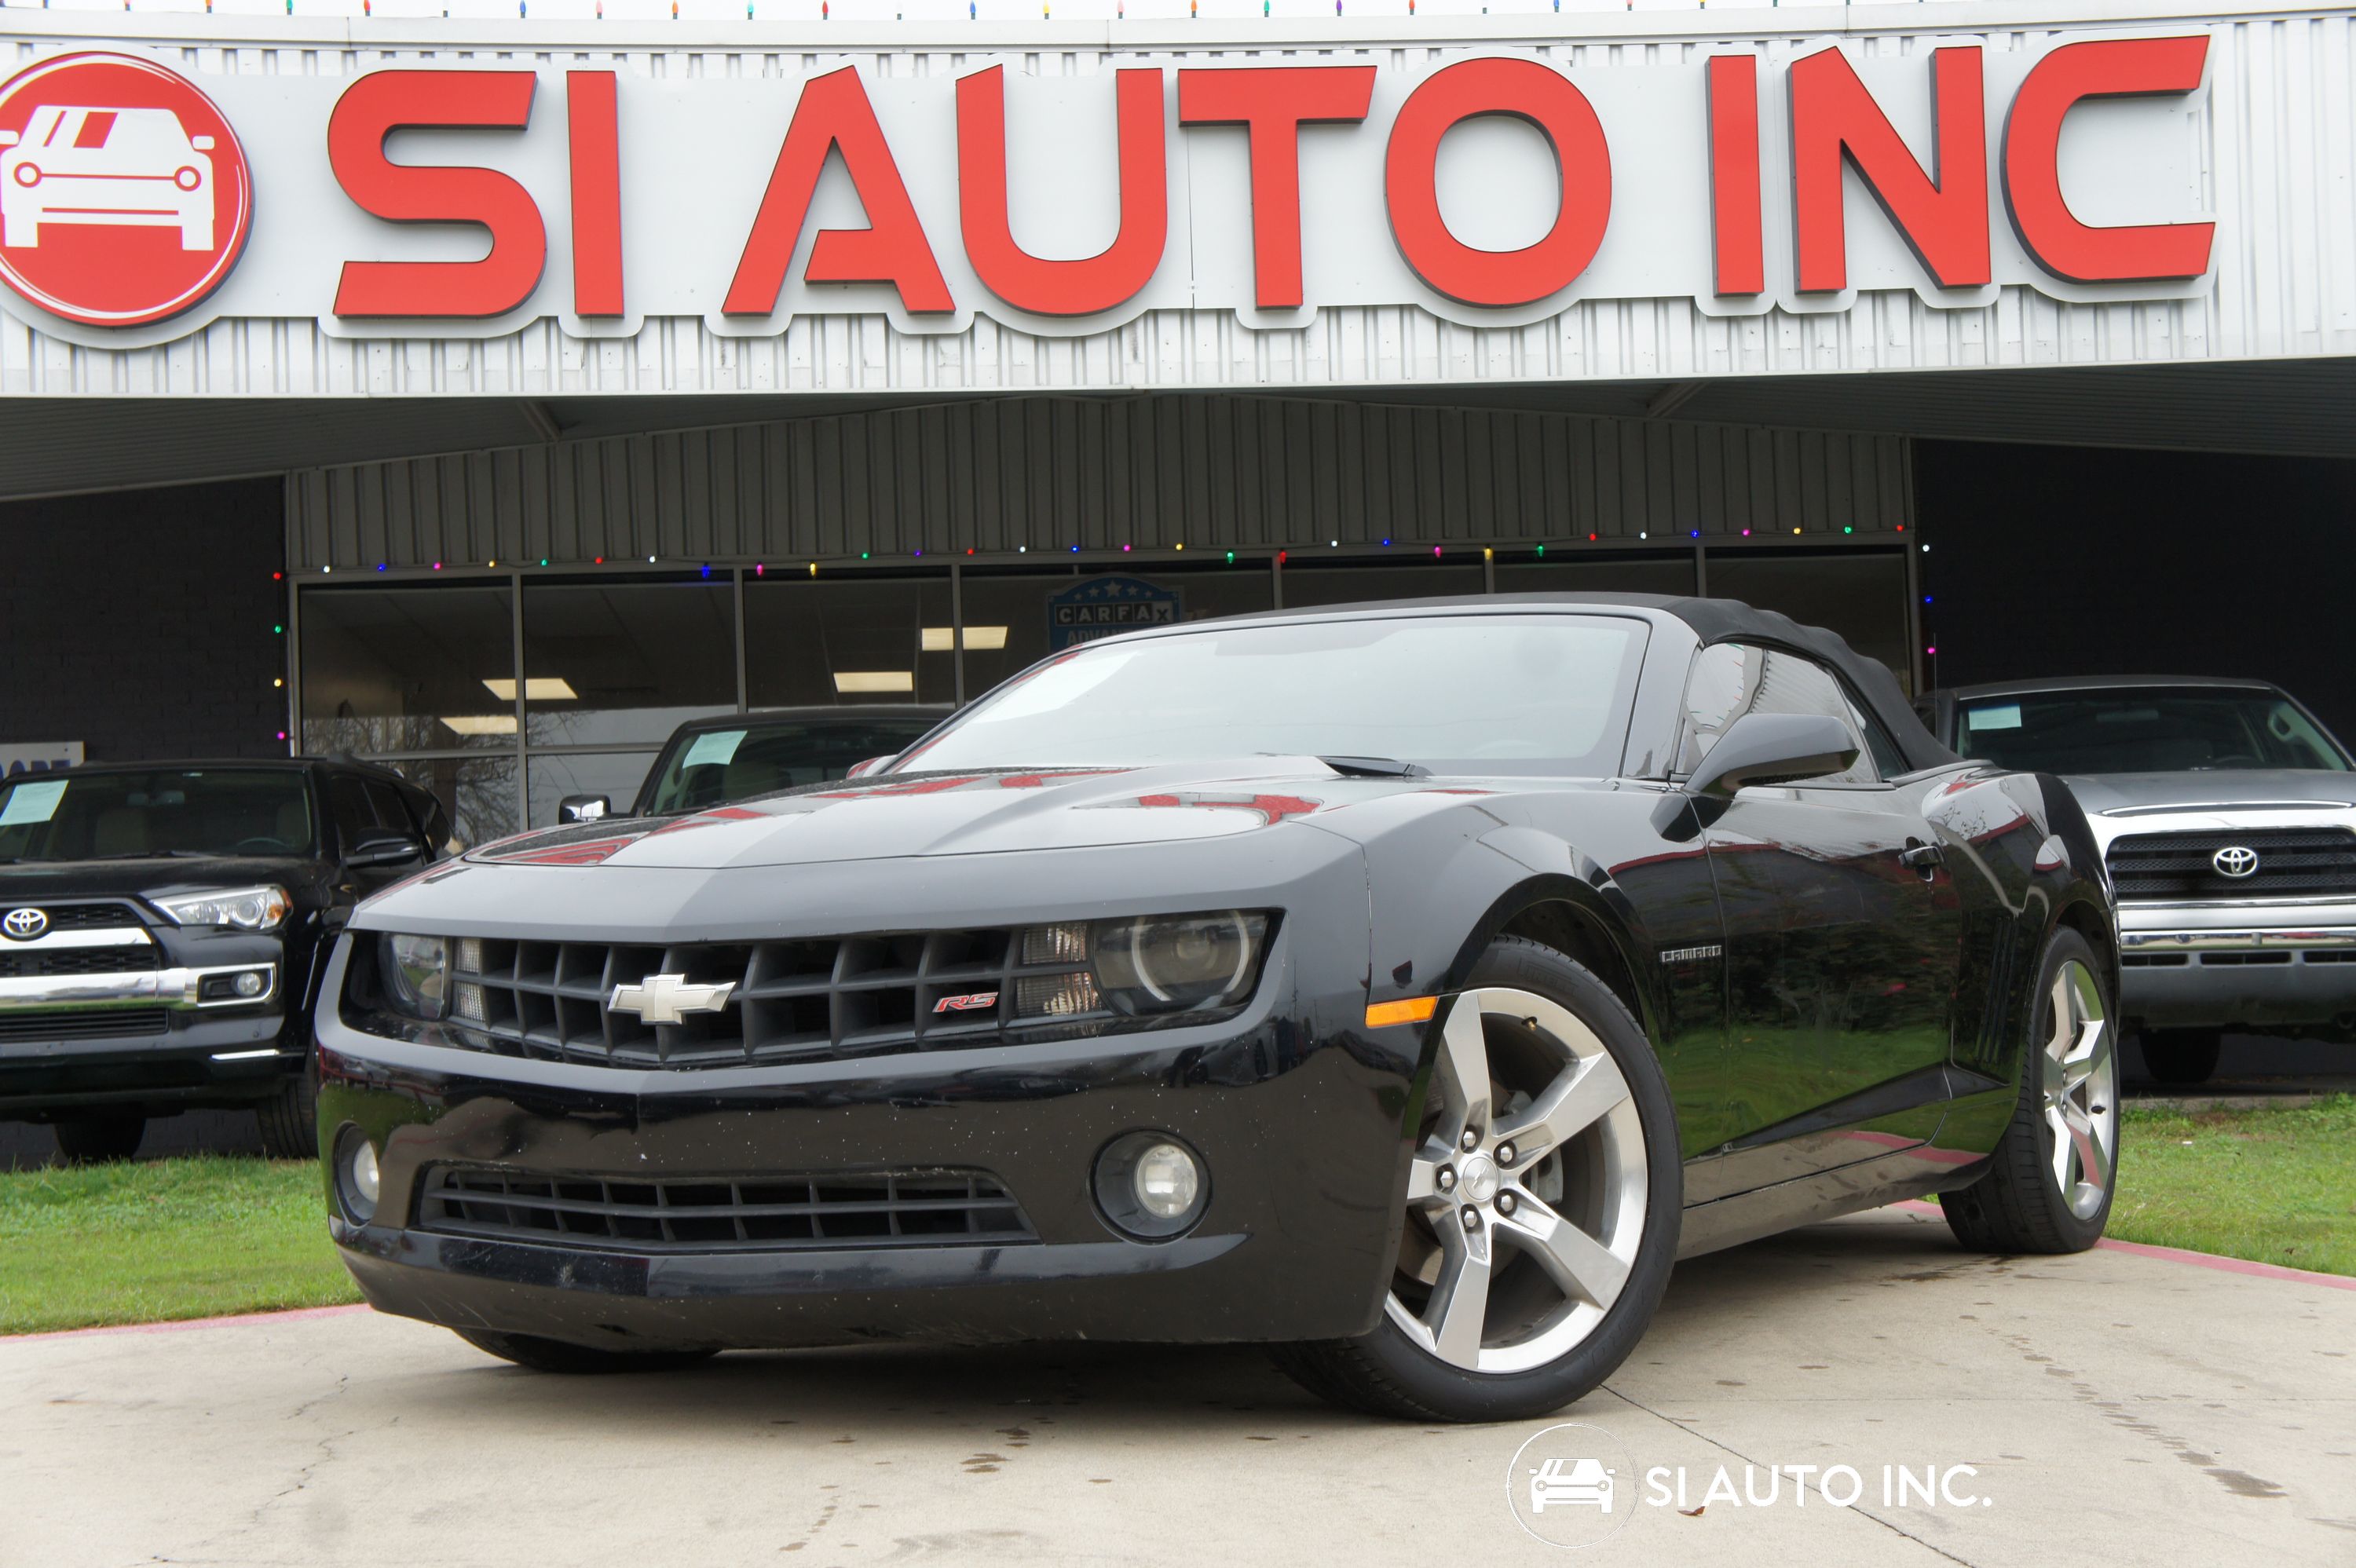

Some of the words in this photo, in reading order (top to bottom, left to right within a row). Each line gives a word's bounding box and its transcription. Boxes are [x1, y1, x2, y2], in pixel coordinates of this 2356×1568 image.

[327, 69, 624, 318] SI
[721, 57, 1612, 317] AUTO
[1706, 35, 2216, 298] INC
[1059, 605, 1169, 623] CARFAX
[932, 992, 999, 1013] RS
